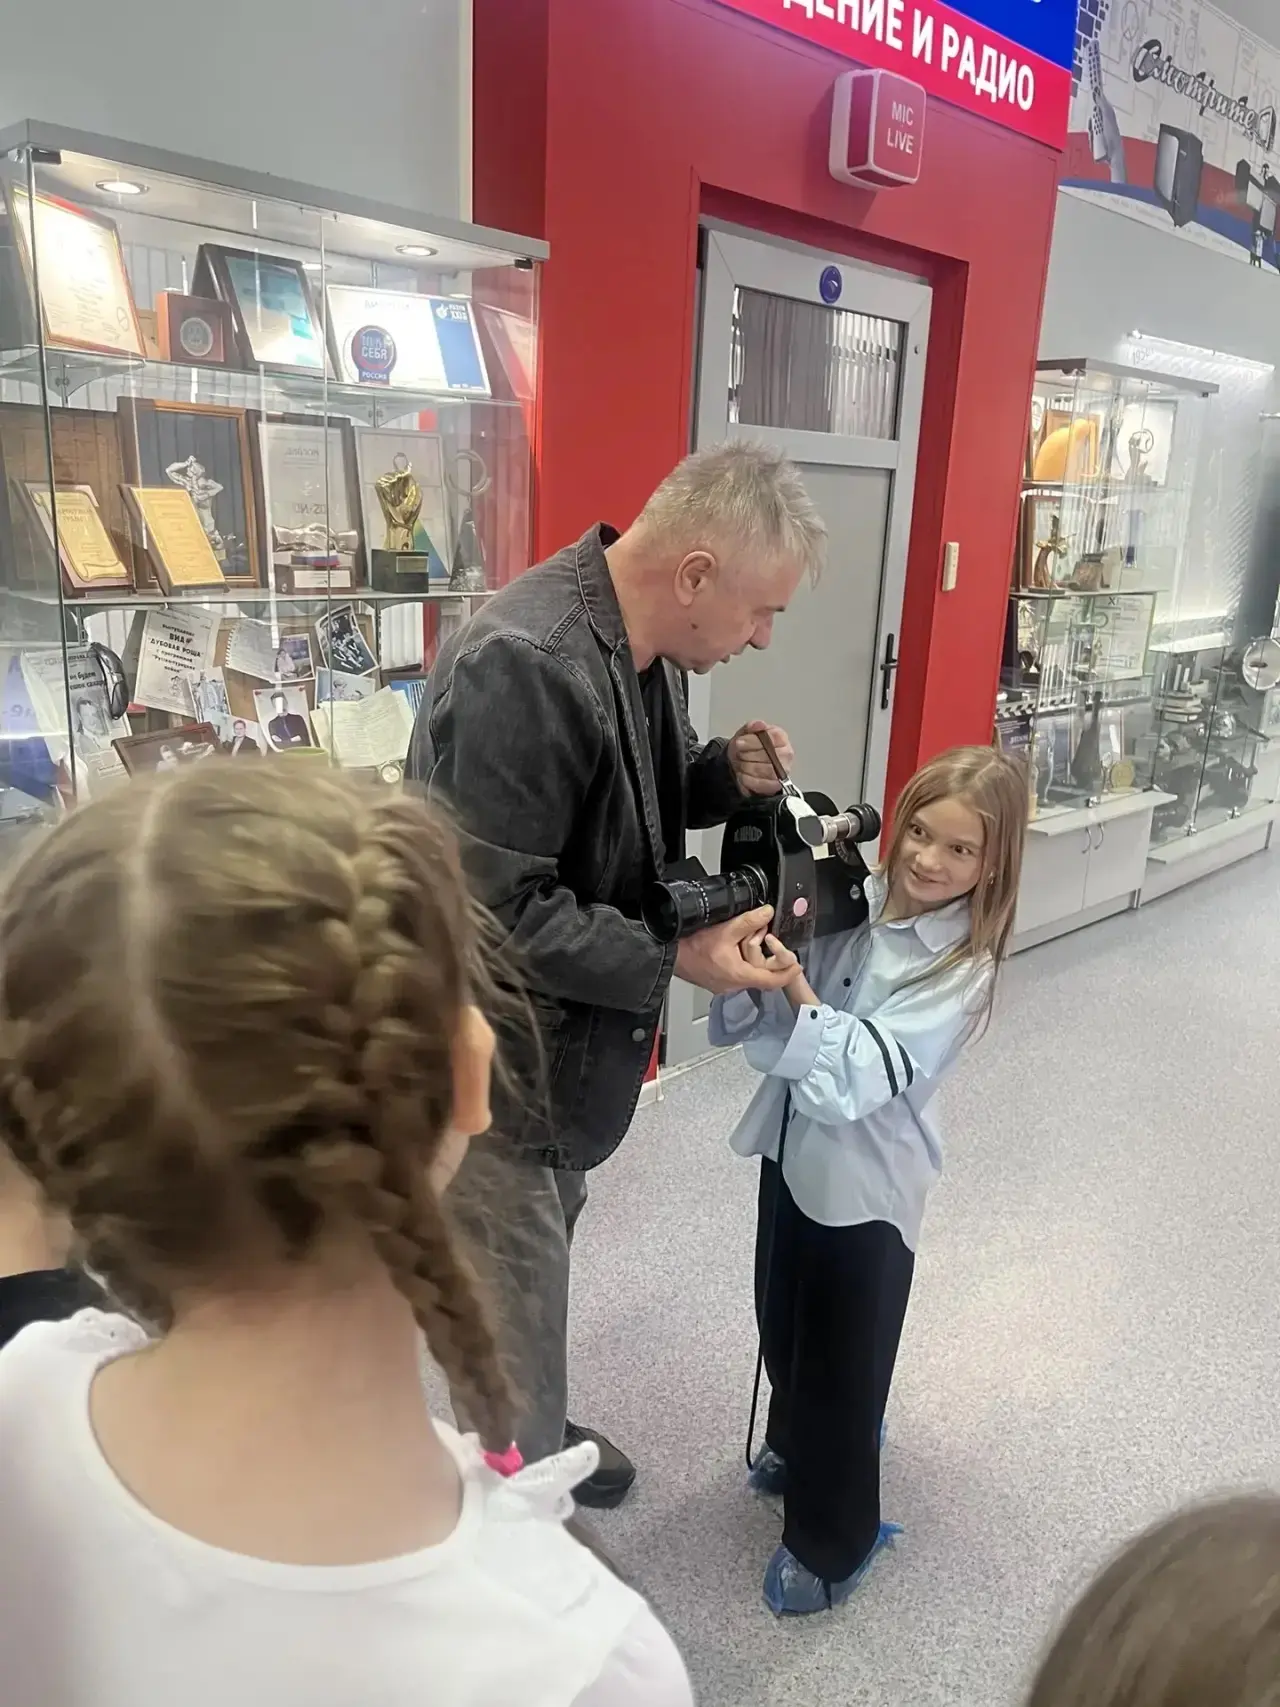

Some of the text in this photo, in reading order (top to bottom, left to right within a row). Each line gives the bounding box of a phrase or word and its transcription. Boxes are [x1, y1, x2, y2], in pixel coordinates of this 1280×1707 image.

[912, 8, 934, 64] И
[941, 23, 1034, 111] РАДИО
[891, 101, 914, 126] MIC
[887, 127, 914, 154] LIVE
[361, 346, 388, 360] СЕБЯ
[362, 371, 387, 380] РОССИЯ
